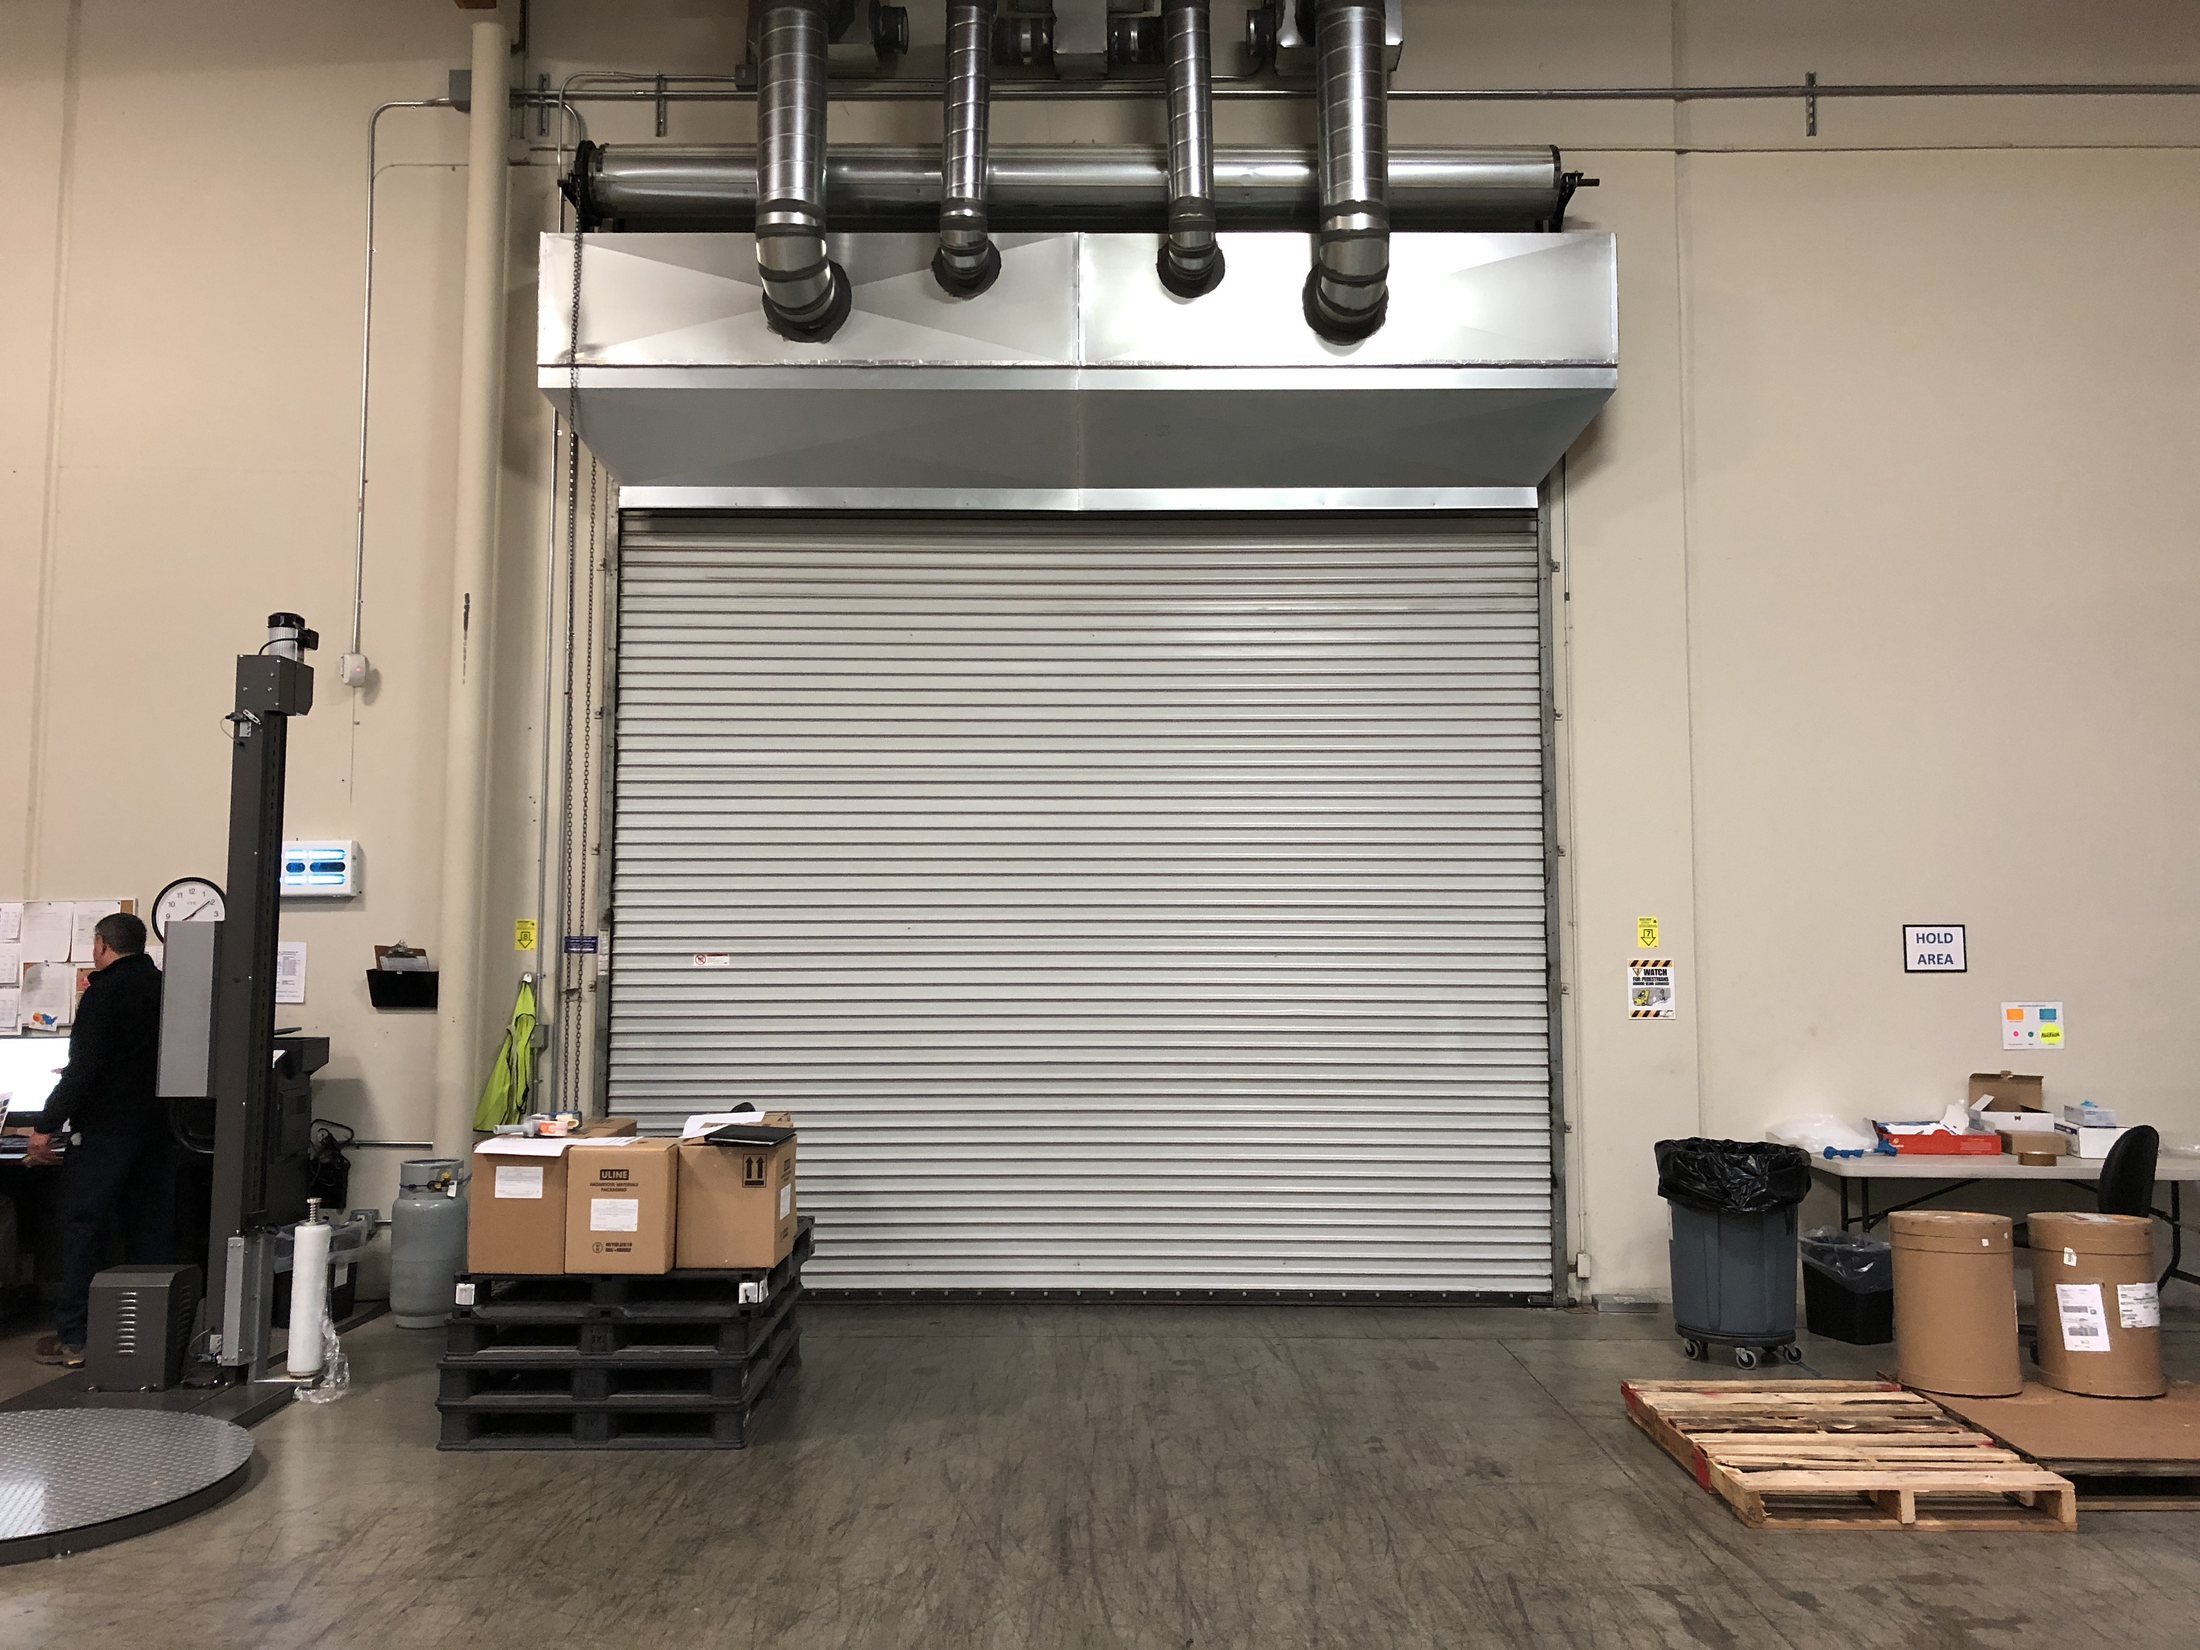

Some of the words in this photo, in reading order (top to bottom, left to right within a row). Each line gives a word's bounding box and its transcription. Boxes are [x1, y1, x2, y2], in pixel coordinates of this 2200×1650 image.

[1916, 932, 1954, 944] HOLD
[1917, 953, 1954, 965] AREA
[1643, 968, 1668, 976] WATCH
[601, 1170, 628, 1179] ULINE
